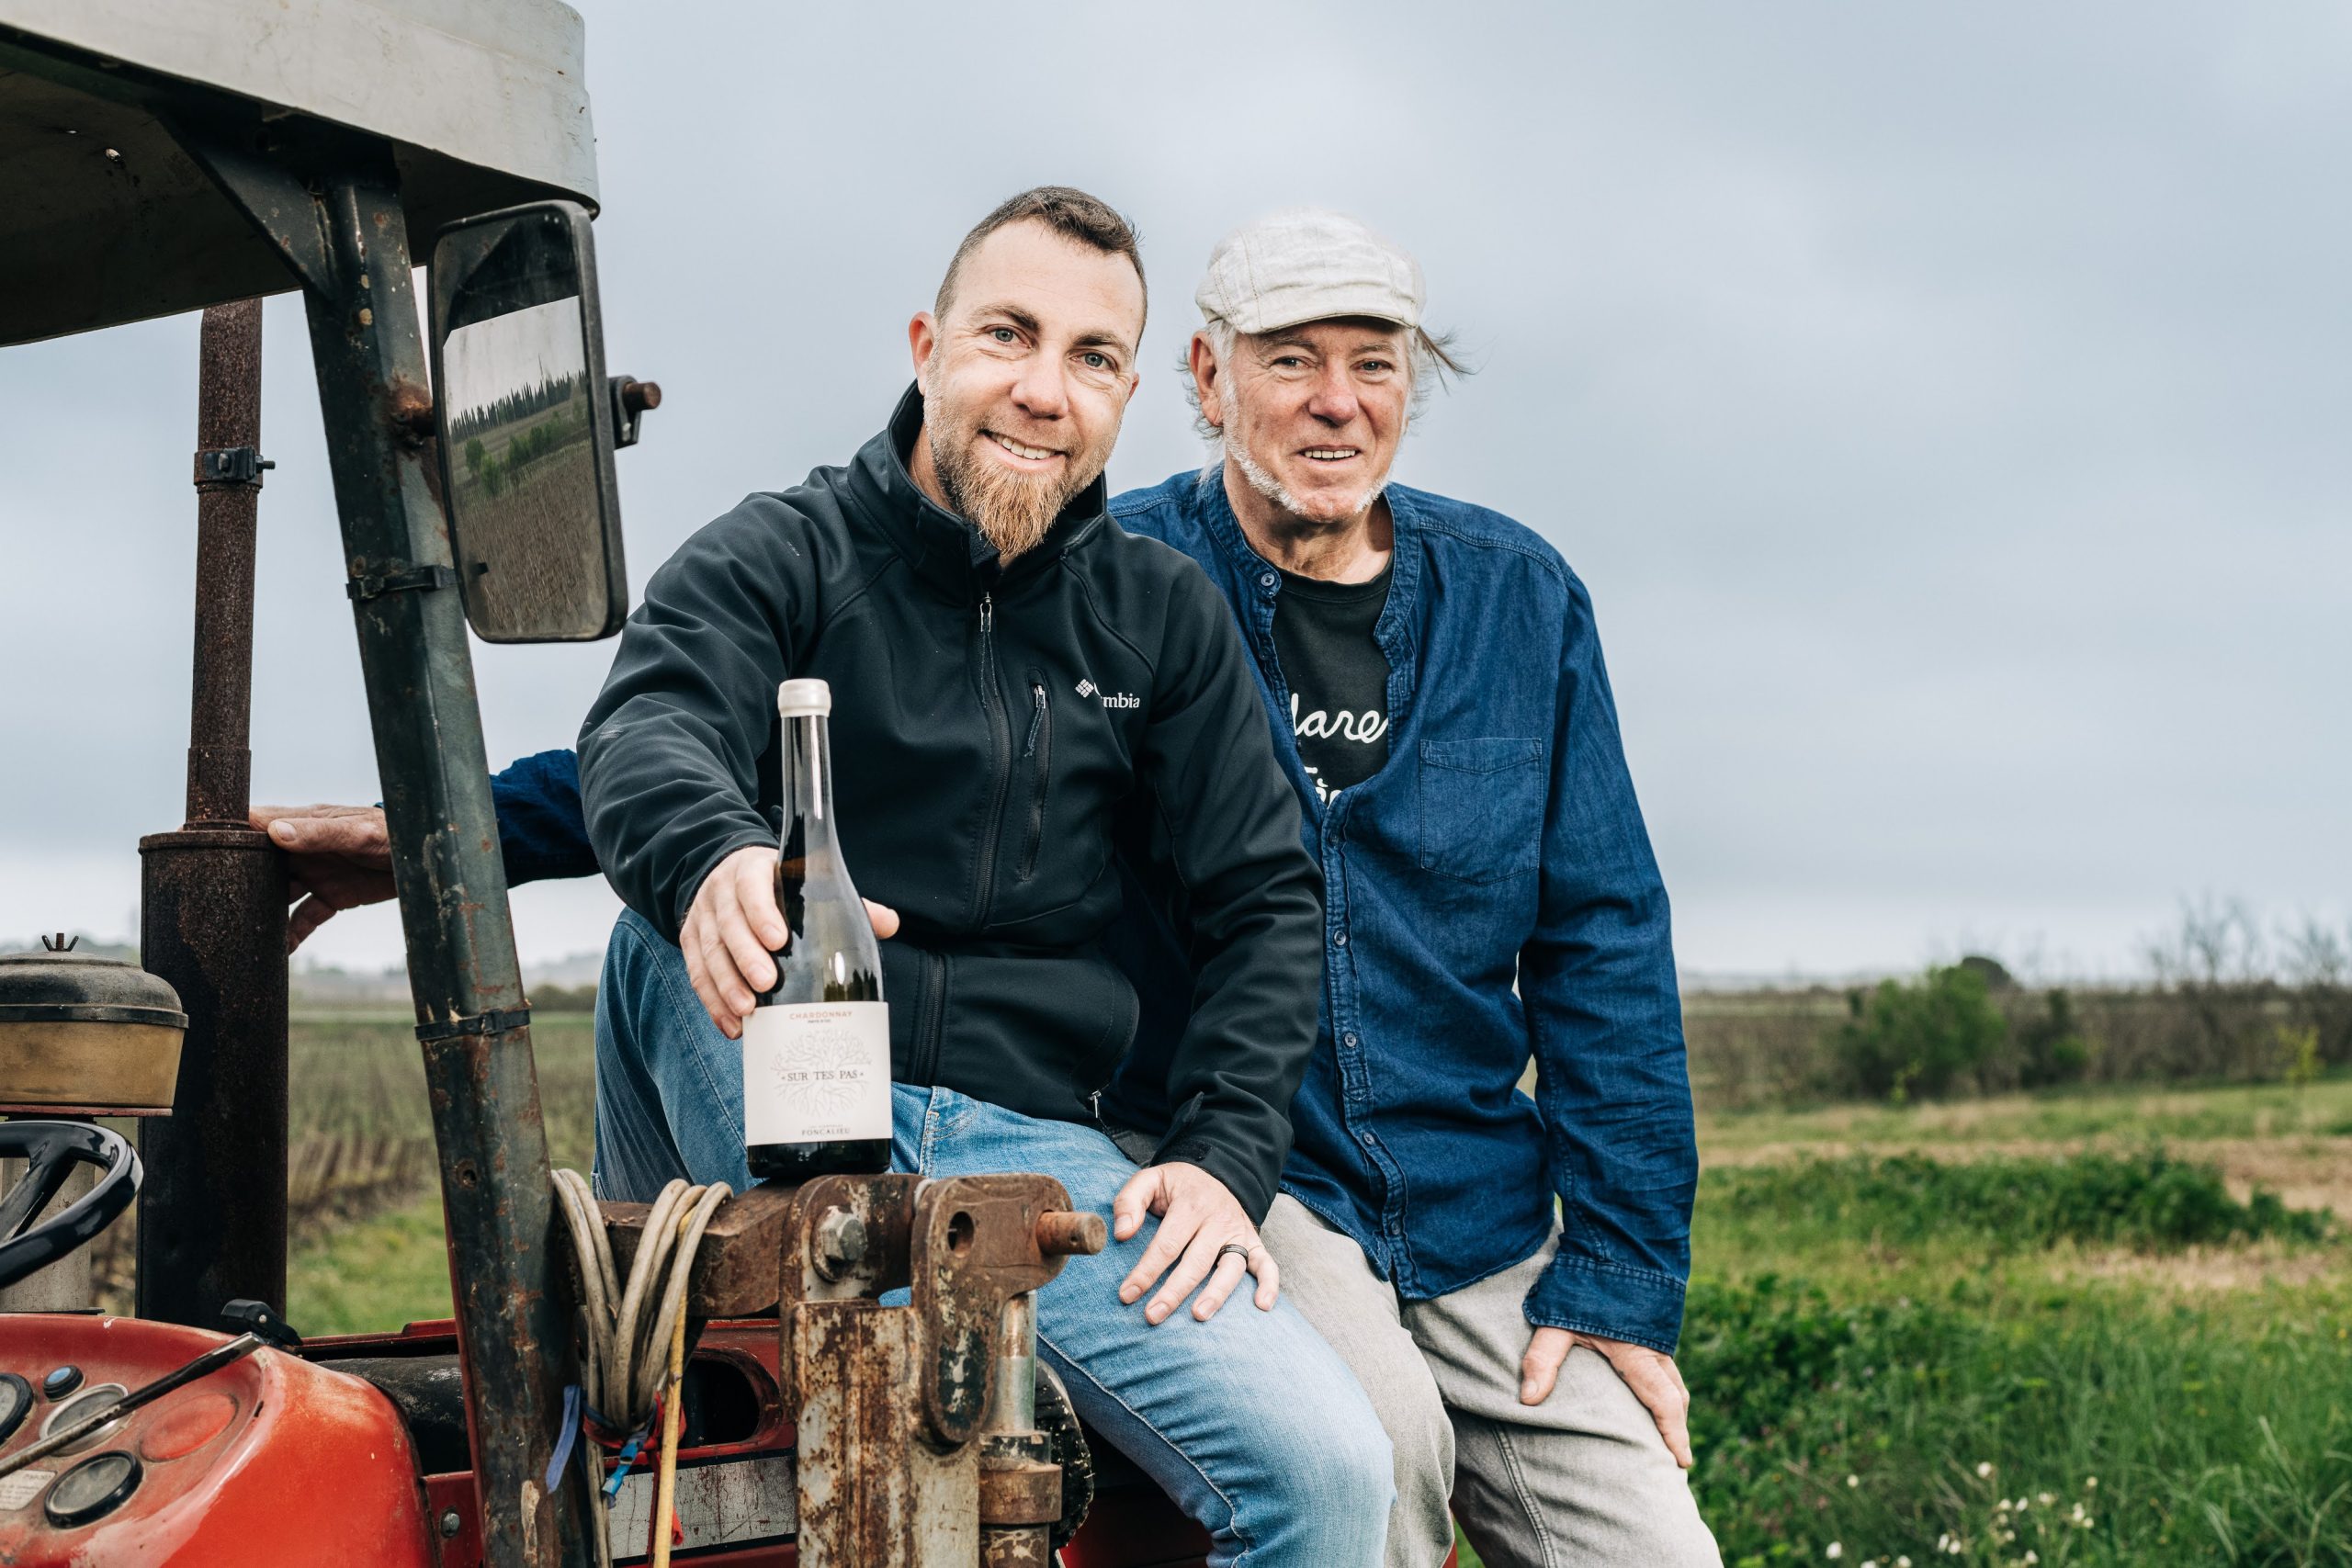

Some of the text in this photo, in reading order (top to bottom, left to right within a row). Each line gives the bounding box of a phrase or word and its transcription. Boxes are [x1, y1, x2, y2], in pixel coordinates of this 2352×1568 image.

[1093, 682, 1140, 708] mbia
[789, 1011, 853, 1020] CHARDONNAY
[787, 1069, 858, 1081] SUR TES PAS
